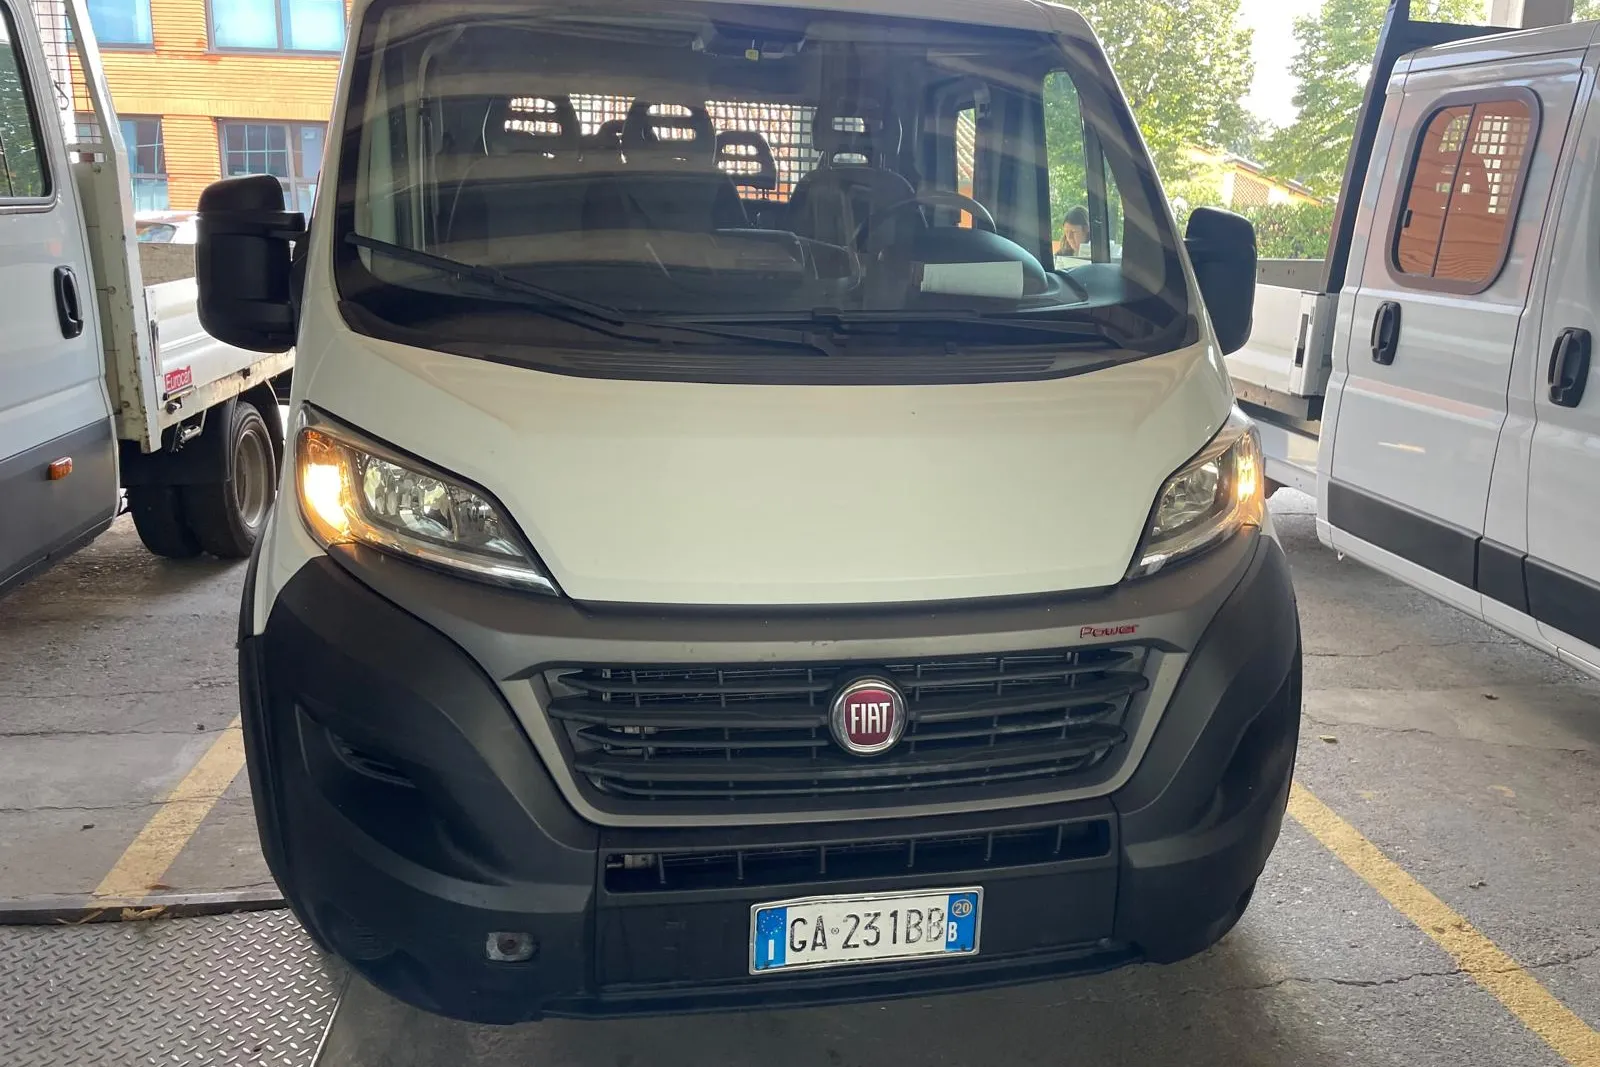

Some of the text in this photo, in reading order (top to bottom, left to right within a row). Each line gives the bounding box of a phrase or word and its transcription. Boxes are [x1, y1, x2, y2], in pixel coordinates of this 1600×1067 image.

[166, 369, 191, 390] Eurocar
[1080, 624, 1138, 638] Power
[851, 702, 890, 734] FIAT
[955, 902, 969, 914] 20
[789, 915, 828, 953] GA
